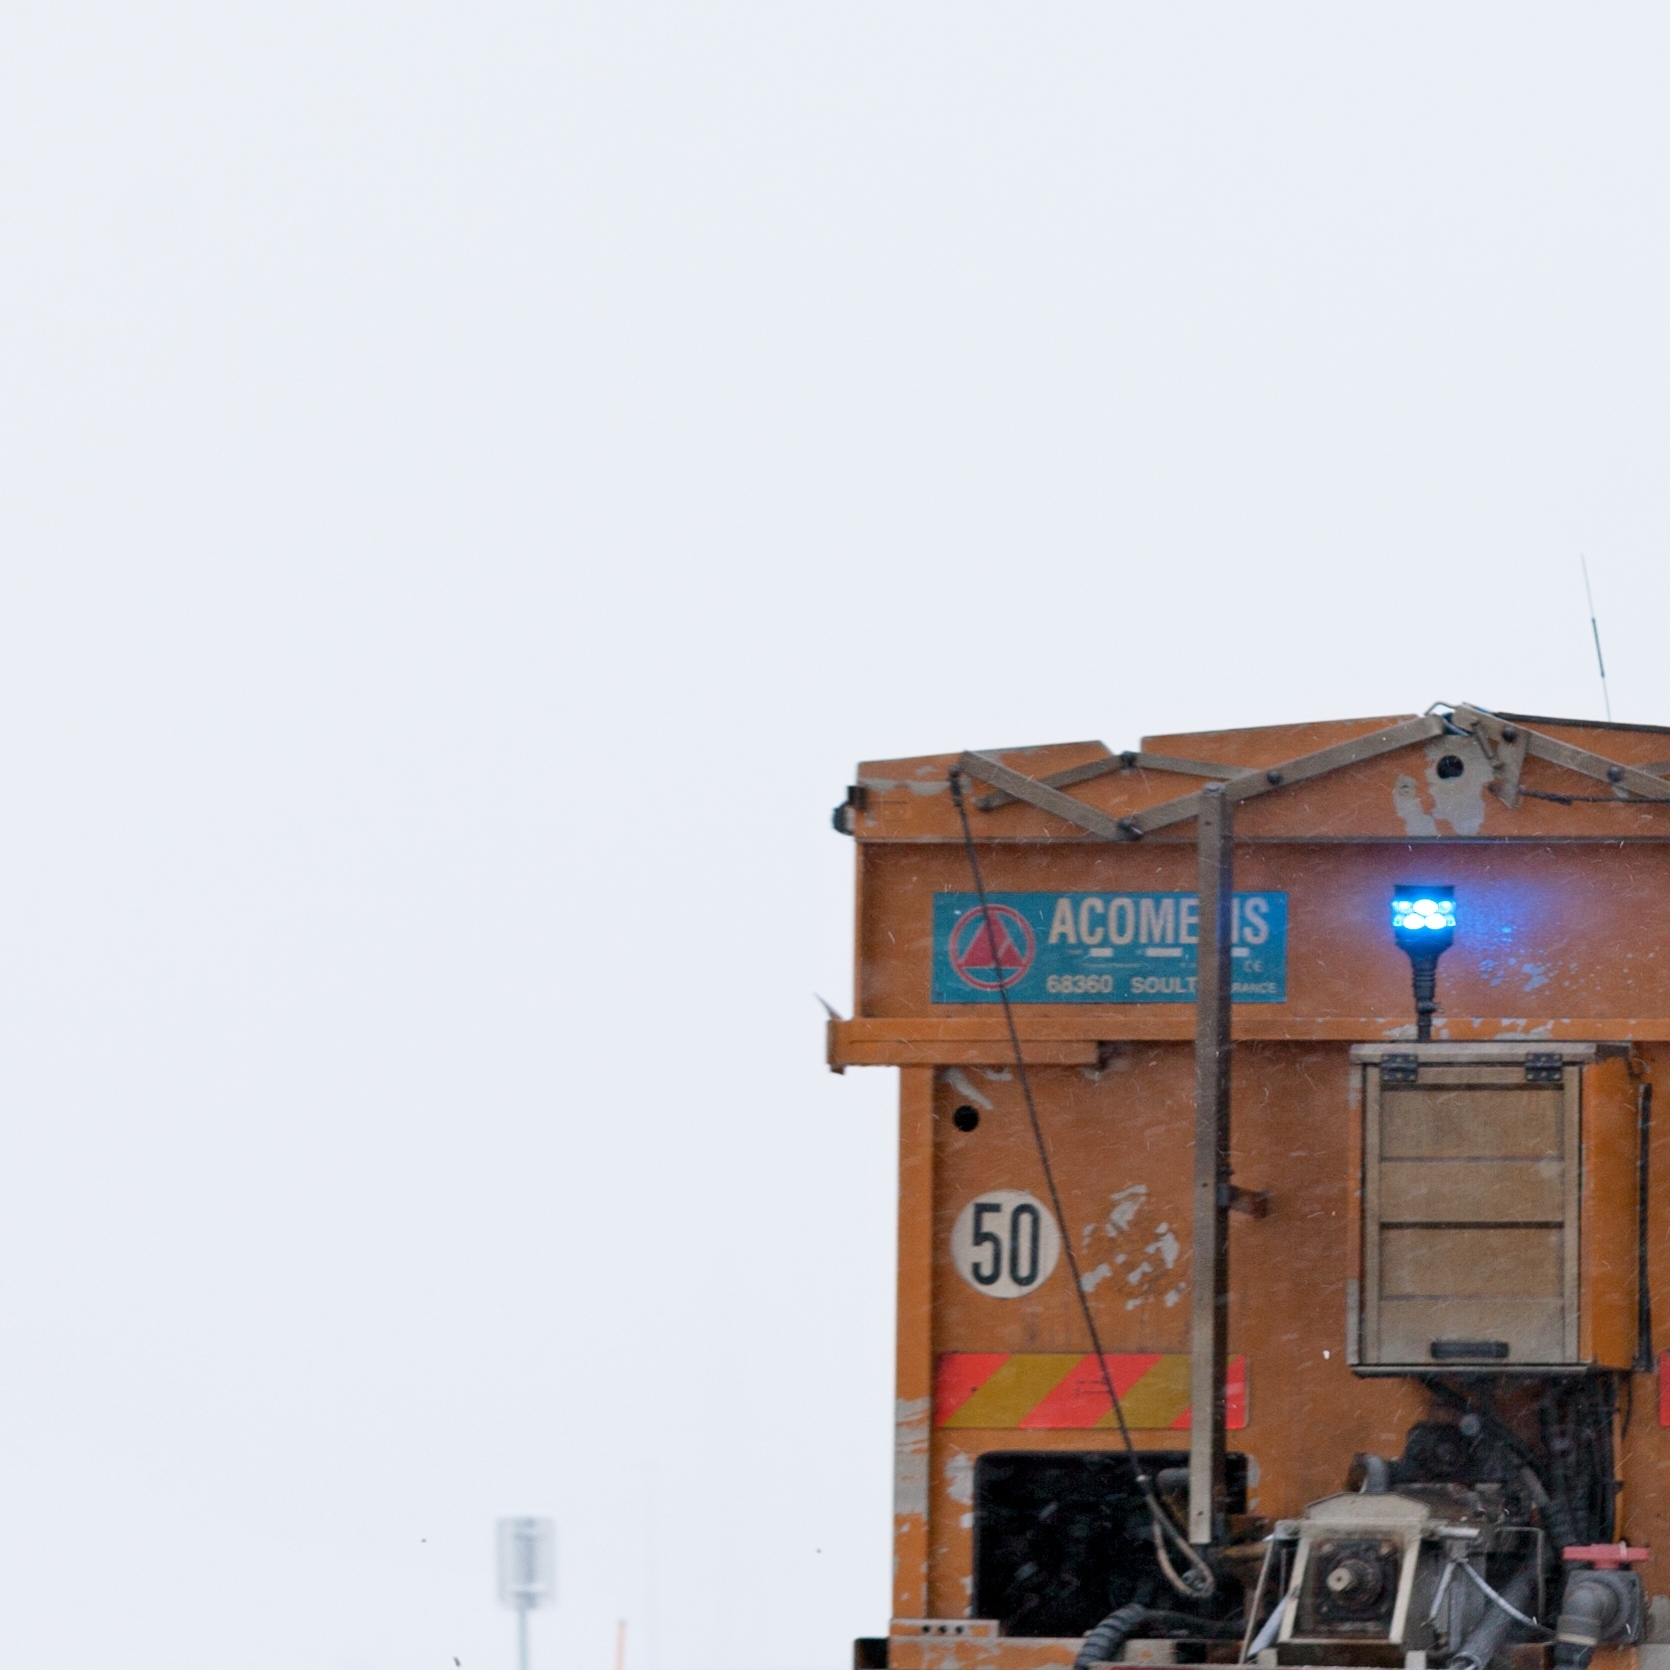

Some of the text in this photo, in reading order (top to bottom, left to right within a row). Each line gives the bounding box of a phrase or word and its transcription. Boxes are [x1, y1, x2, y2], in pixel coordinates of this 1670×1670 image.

[1048, 897, 1270, 945] ACOMEIS
[1045, 974, 1278, 995] 68360 SOULT RANCE
[972, 1203, 1040, 1287] 50
